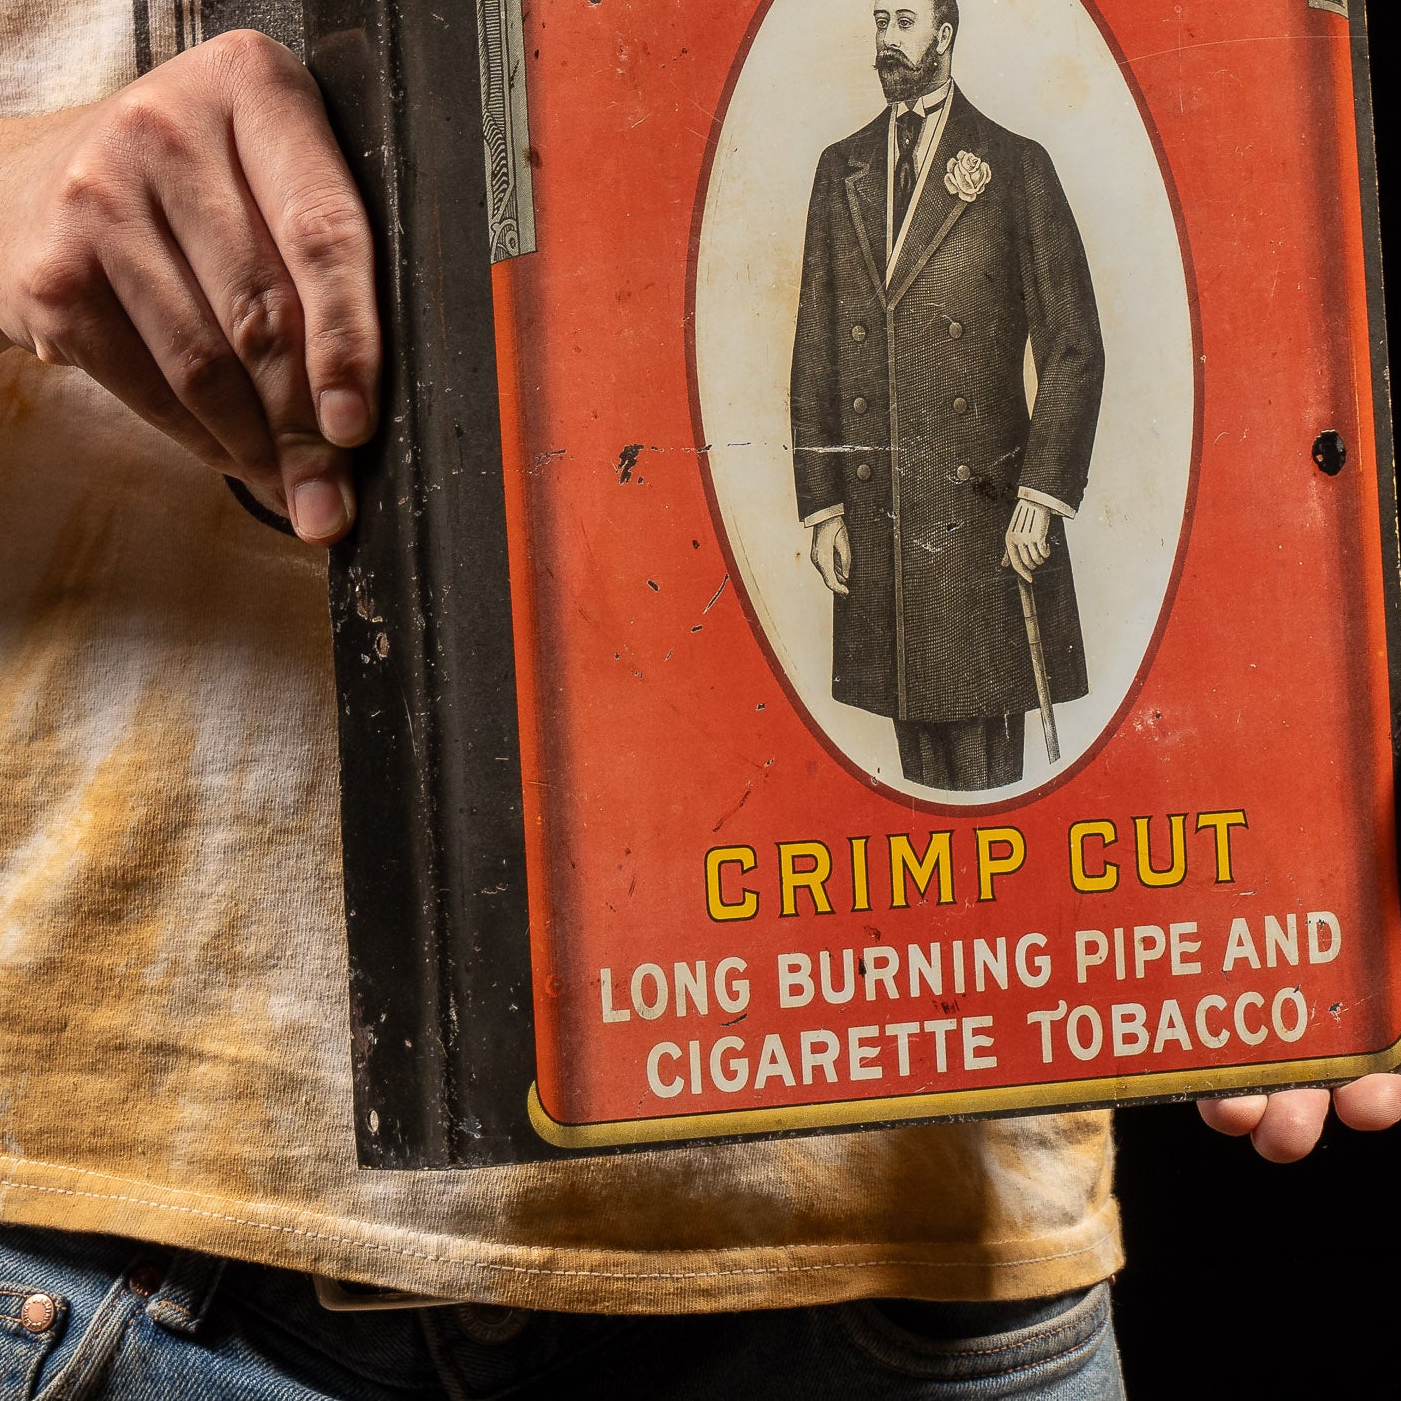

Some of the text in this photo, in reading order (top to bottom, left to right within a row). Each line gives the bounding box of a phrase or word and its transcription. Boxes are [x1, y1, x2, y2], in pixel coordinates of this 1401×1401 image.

[703, 808, 1250, 923] CRIMP CUT
[598, 910, 1343, 1024] LONG BURNING PIPE AND
[645, 986, 1310, 1099] CIGARETTE TOBACCO
